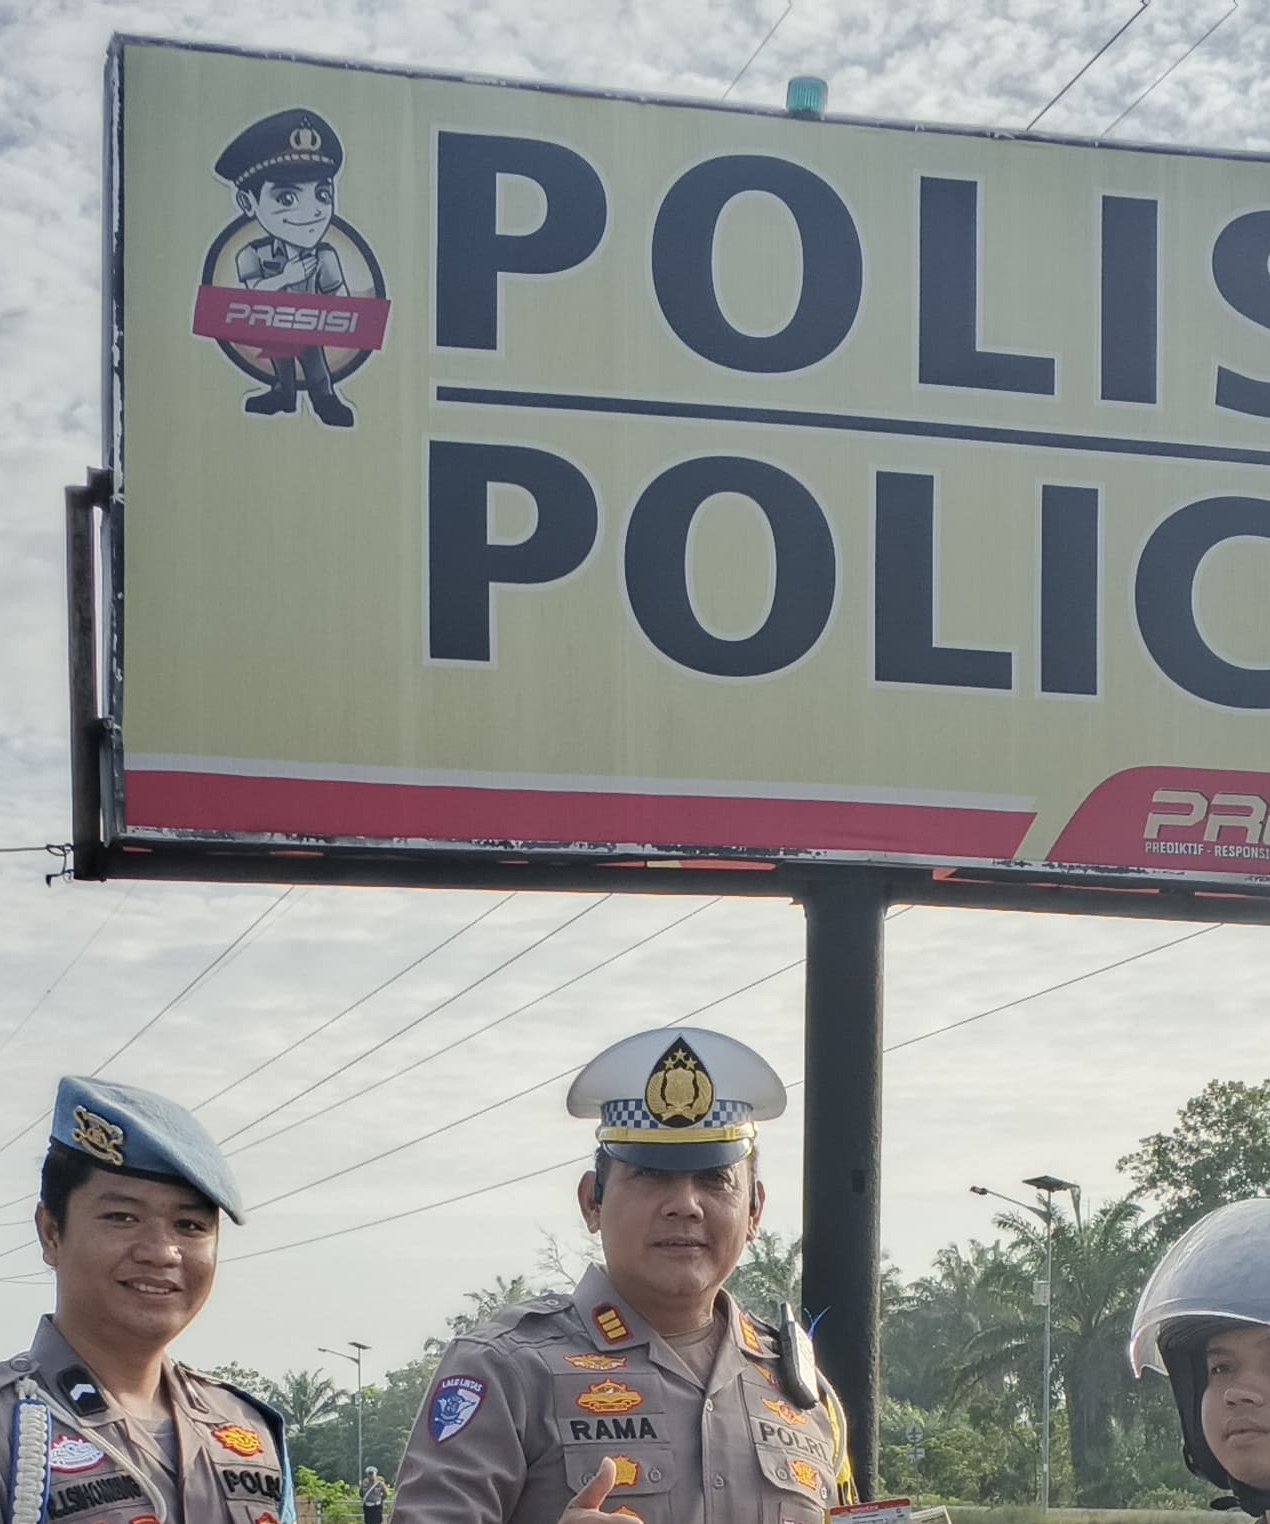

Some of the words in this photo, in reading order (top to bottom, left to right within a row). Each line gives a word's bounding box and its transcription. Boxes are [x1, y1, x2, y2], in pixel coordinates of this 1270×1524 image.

[225, 302, 360, 334] PRESISI
[1144, 841, 1205, 857] PREDIKTIF
[570, 1417, 658, 1441] RAMA
[758, 1421, 828, 1461] POLRI
